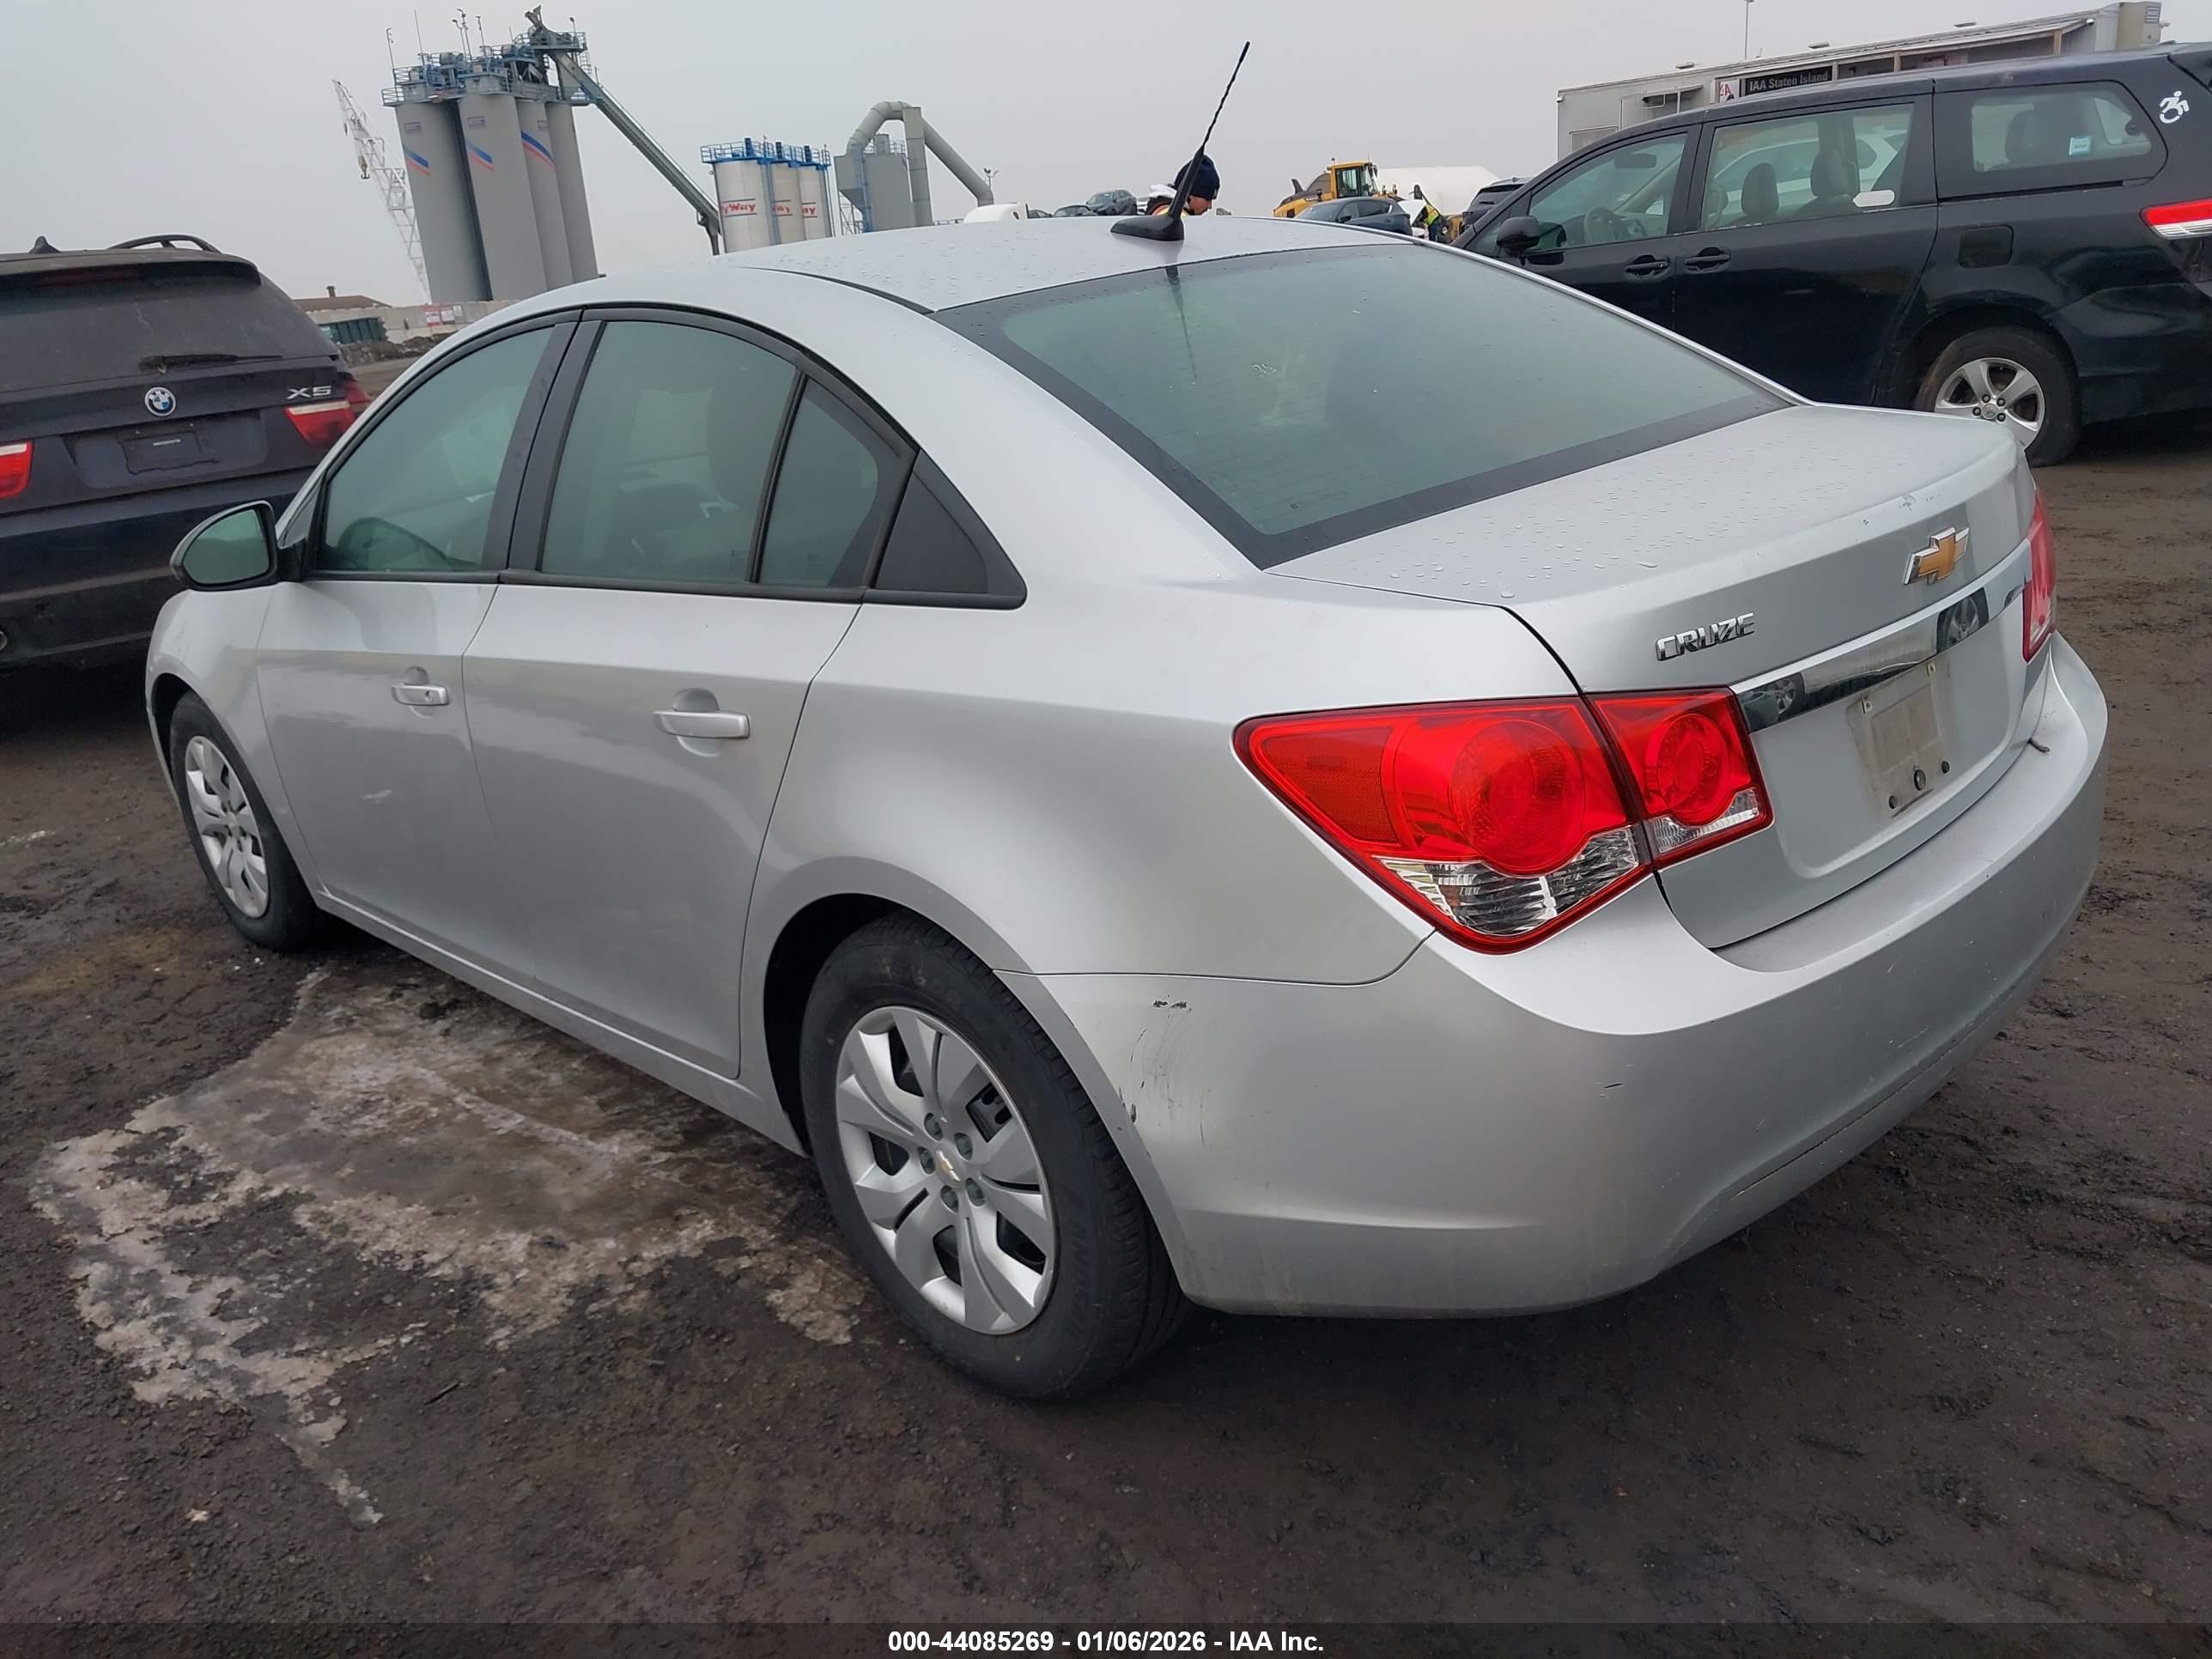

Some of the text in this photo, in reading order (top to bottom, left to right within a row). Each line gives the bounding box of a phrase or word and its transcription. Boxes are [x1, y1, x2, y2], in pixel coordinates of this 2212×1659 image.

[1749, 70, 1828, 92] IAA Staten Island
[286, 385, 331, 400] X5
[1655, 611, 1755, 661] CRUZE
